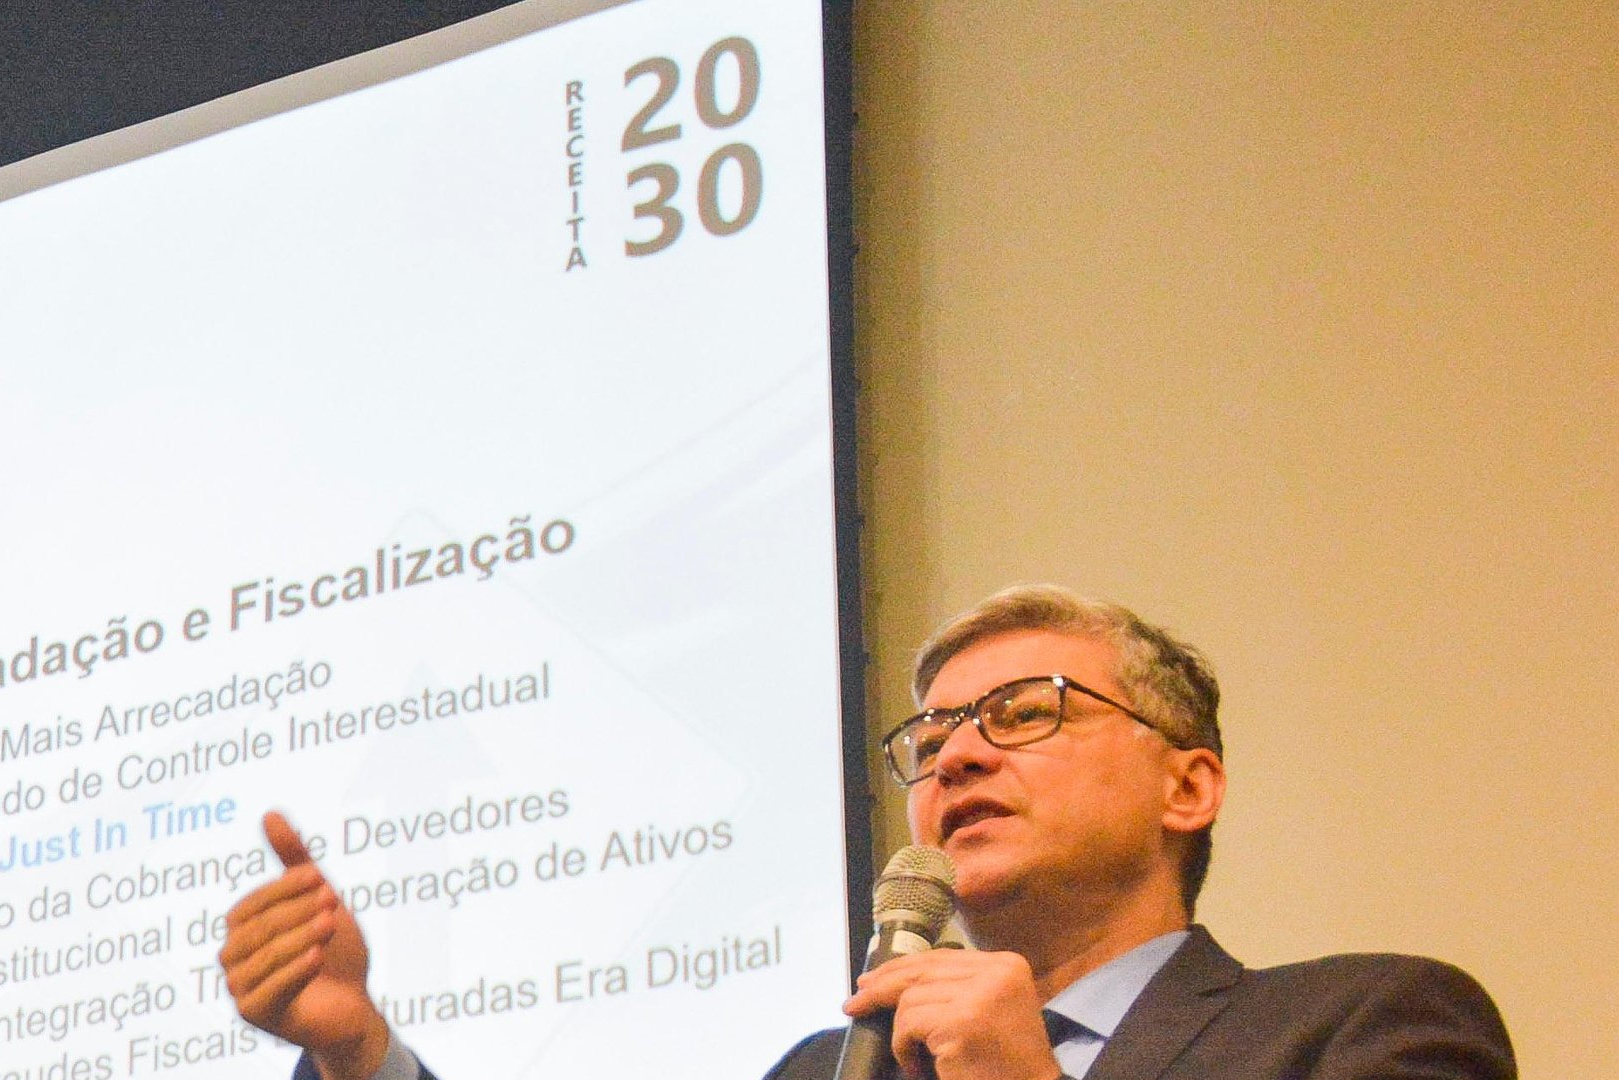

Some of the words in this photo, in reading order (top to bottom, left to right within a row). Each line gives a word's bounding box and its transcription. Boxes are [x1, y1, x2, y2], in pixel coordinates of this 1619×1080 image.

[621, 36, 762, 153] 20
[566, 80, 587, 272] RECEITA
[624, 142, 763, 257] 30
[182, 608, 211, 642] e
[230, 514, 577, 631] Fiscalização
[0, 715, 84, 763] Mais
[94, 659, 333, 742] Arrecadação
[58, 767, 104, 804] de
[117, 726, 274, 791] Controle
[289, 661, 551, 752] Interestadual
[27, 885, 72, 923] da
[87, 849, 265, 908] Cobrança
[343, 788, 571, 856] Devedores
[94, 817, 128, 854] In
[142, 796, 238, 840] Time
[187, 909, 227, 948] de
[337, 855, 518, 913] peração
[534, 841, 588, 882] de
[600, 819, 733, 871] Ativos
[128, 1016, 259, 1076] Fiscais
[555, 960, 629, 1003] Era
[647, 925, 782, 991] Digital
